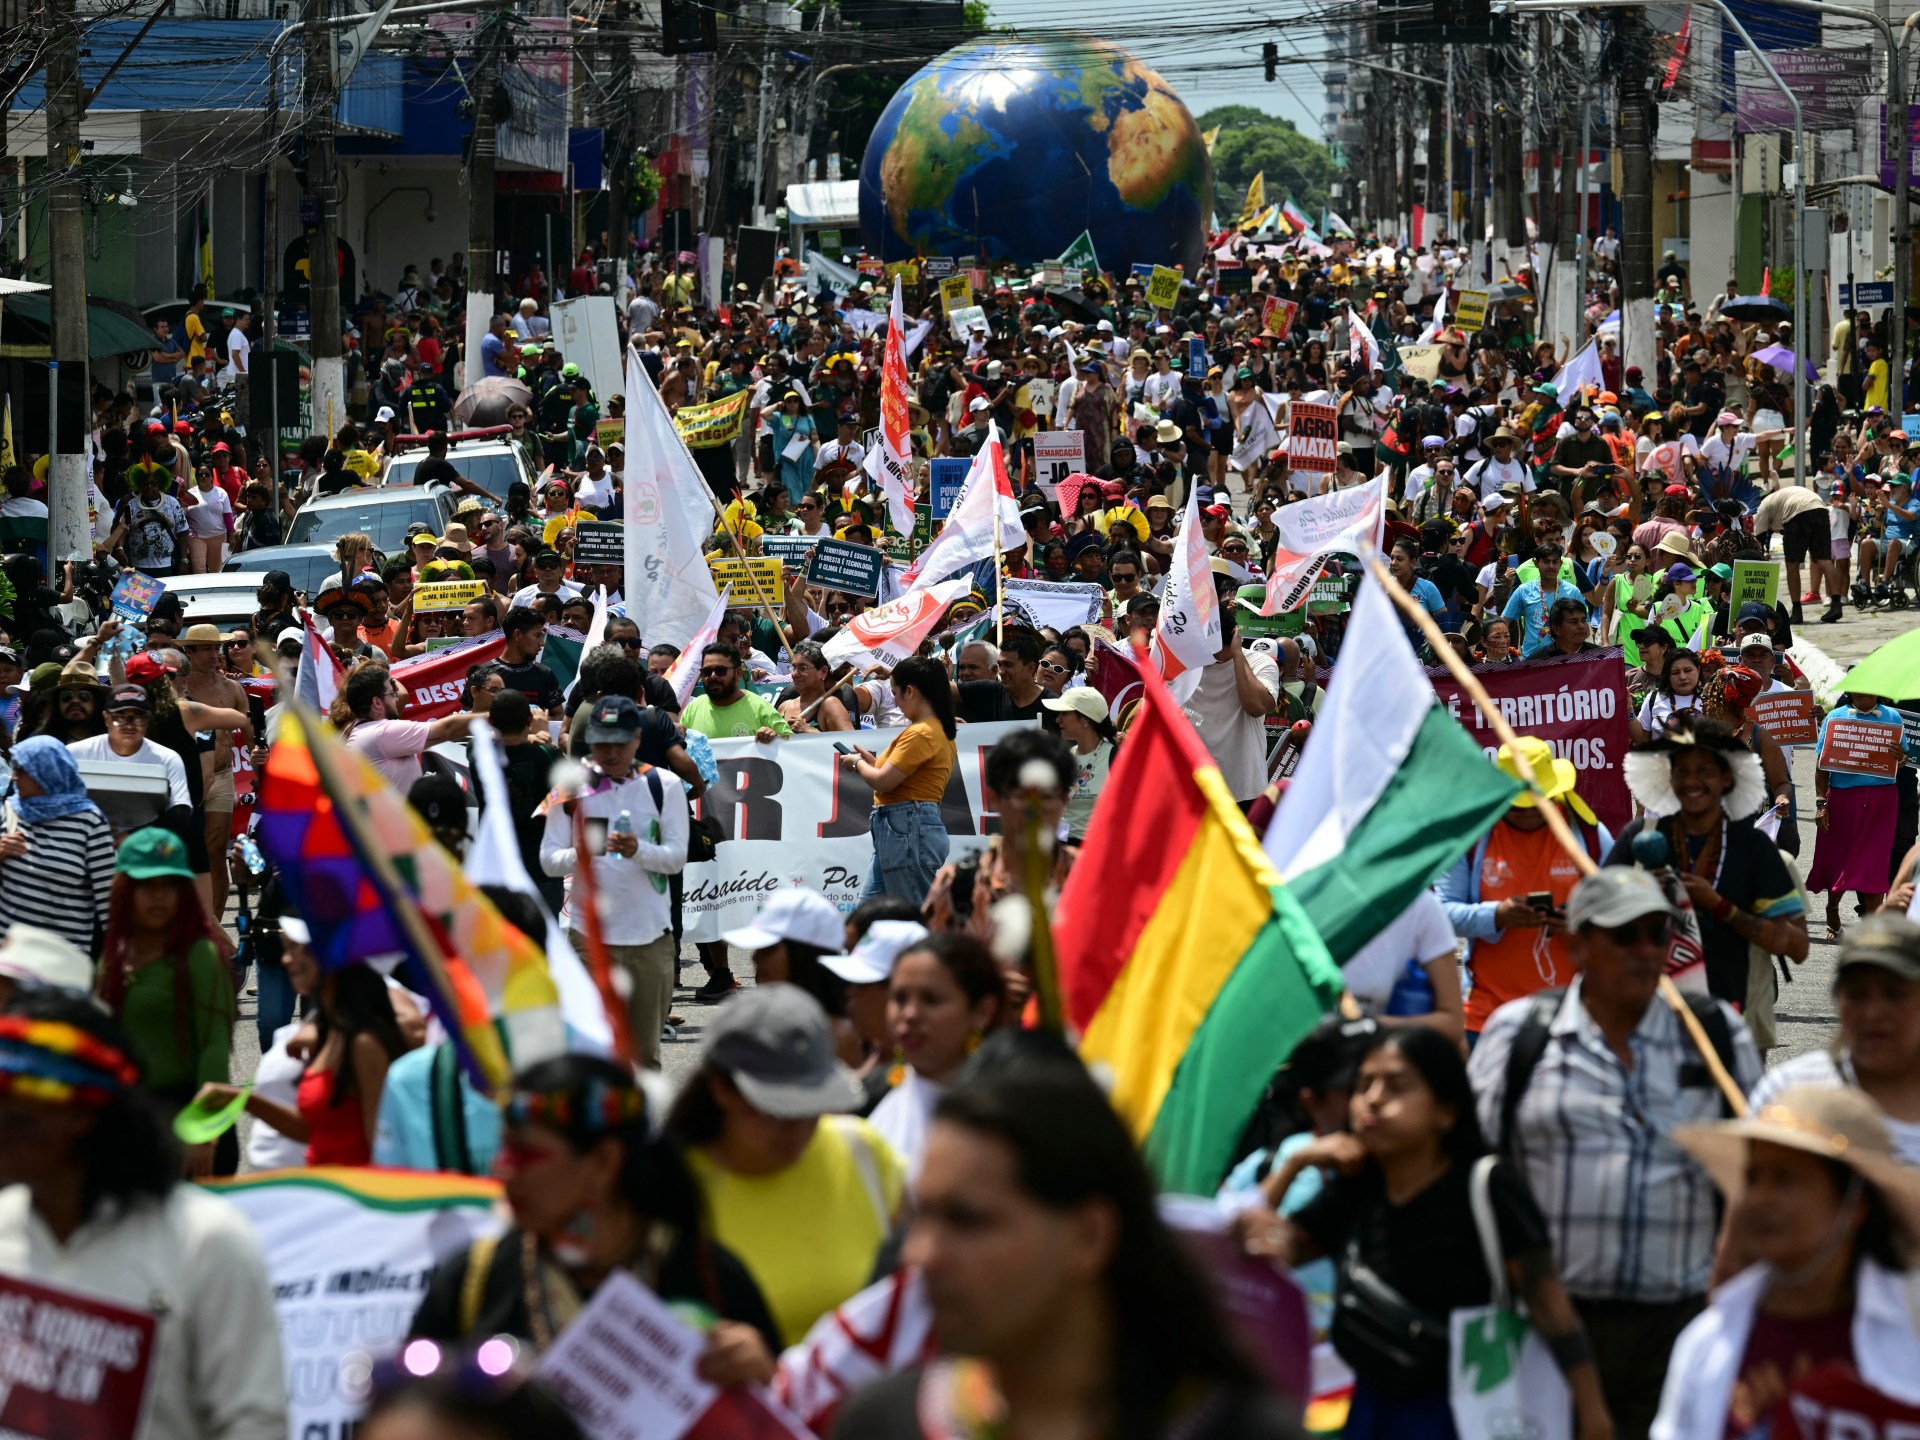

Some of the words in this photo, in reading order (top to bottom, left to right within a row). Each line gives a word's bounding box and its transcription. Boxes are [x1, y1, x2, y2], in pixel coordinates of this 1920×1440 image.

[1151, 286, 1160, 296] IS
[1162, 288, 1173, 299] US
[599, 429, 623, 438] poder
[1292, 417, 1335, 438] AGRO
[1036, 447, 1082, 458] DEMARCAÇÃO
[1290, 437, 1336, 460] MATA
[940, 473, 953, 485] EM
[940, 497, 951, 510] DE
[790, 543, 795, 551] É
[823, 545, 850, 557] TERRITÓRIO
[849, 549, 854, 558] É
[886, 547, 923, 556] CLIMÁTCA
[739, 561, 765, 569] TEITÓRIO
[818, 553, 840, 565] FLORESTA
[841, 557, 845, 565] É
[717, 571, 743, 579] GARANTIDO
[751, 569, 775, 578] OTEGIDO,
[822, 564, 838, 572] CLIMA
[838, 565, 843, 574] É
[1753, 570, 1770, 578] JUSTIÇA
[737, 588, 747, 596] NÃO
[747, 587, 755, 595] HÁ
[1313, 581, 1343, 592] PEITEM
[1742, 586, 1756, 599] NÃO
[1756, 587, 1766, 599] HÁ
[439, 591, 449, 600] NÃO
[449, 591, 457, 599] HÁ
[1281, 575, 1311, 611] direitos
[112, 605, 142, 622] ecosurf
[1022, 601, 1042, 630] INDÍGEN
[415, 678, 467, 706] DEST
[1755, 702, 1774, 712] MARCO
[1774, 699, 1803, 709] TEMPORAL
[1758, 710, 1780, 721] DESTRÓI
[1781, 720, 1786, 728] E
[1786, 720, 1791, 728] O
[1791, 719, 1811, 727] CLIMA.
[1834, 724, 1858, 733] EDUCAÇÃO
[1858, 726, 1868, 734] QUE
[1868, 727, 1883, 736] NASCE
[1883, 729, 1893, 737] DOS
[1833, 731, 1861, 742] TERRITÓRIOS
[1865, 735, 1885, 744] POLÍTICA
[1832, 740, 1850, 749] FUTURO
[1854, 742, 1879, 752] SOBERANIA
[682, 895, 737, 914] Trabalhadores
[739, 894, 754, 903] em
[841, 892, 854, 901] do
